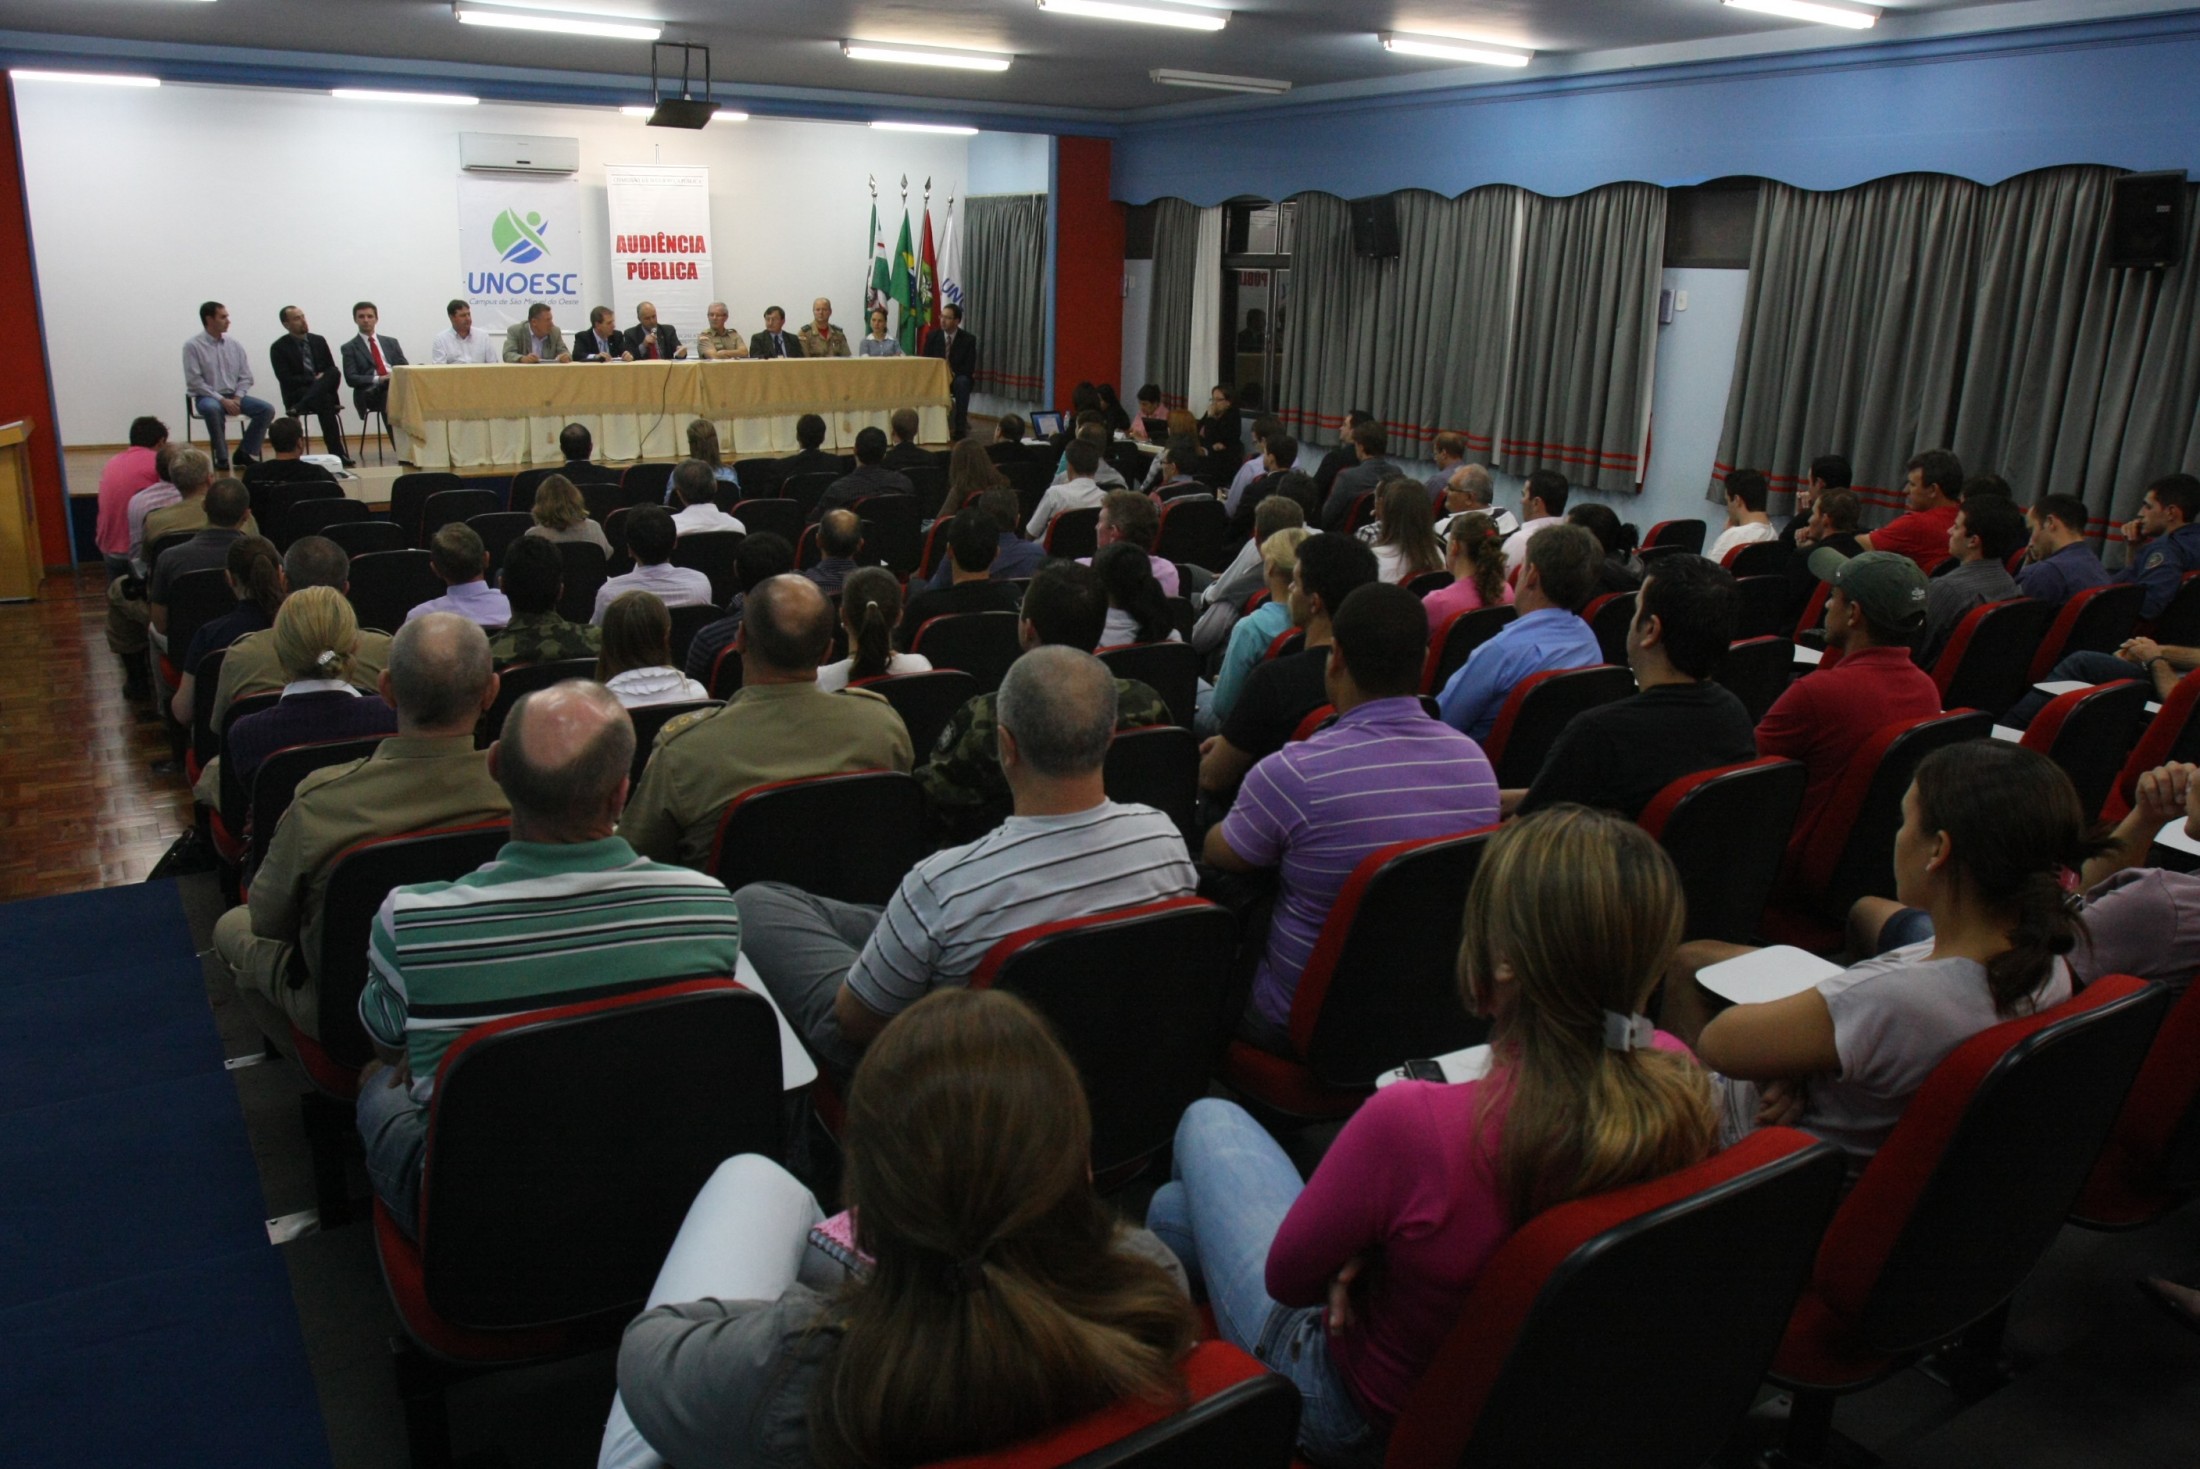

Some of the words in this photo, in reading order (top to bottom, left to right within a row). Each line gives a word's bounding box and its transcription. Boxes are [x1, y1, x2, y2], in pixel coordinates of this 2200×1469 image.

[616, 232, 706, 253] AUDIÊNCIA
[627, 258, 698, 280] PÚBLICA
[468, 272, 577, 295] UNOESC
[469, 297, 497, 306] Campus
[499, 297, 508, 305] de
[510, 297, 522, 305] São
[548, 297, 557, 305] do
[559, 298, 579, 306] Oeste
